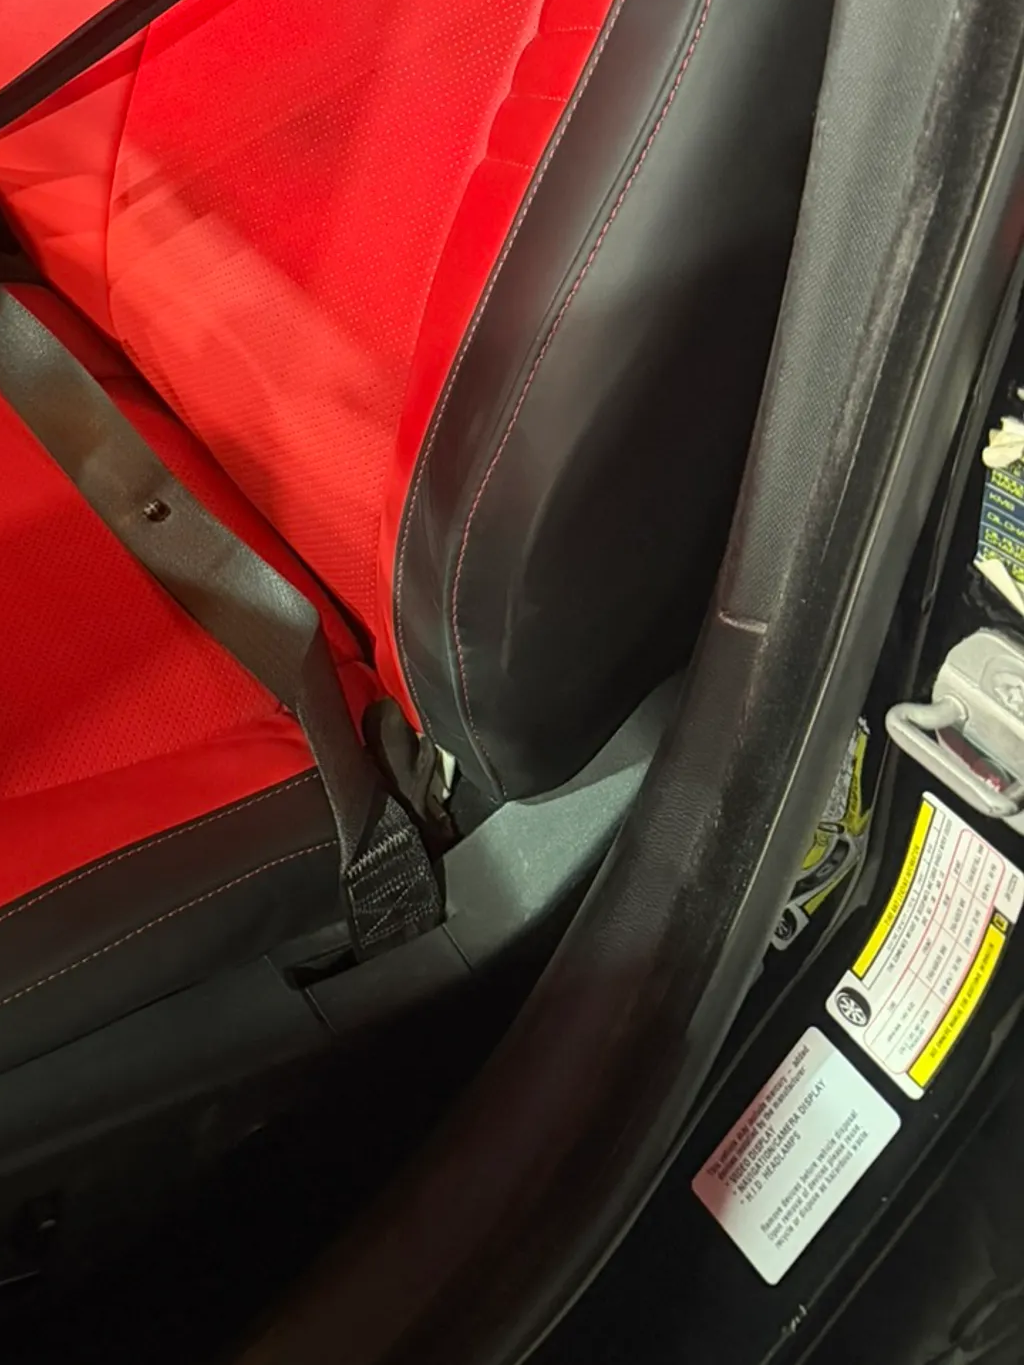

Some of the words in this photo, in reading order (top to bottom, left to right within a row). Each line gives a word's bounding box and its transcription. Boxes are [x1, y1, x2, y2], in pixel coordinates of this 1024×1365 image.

[728, 1156, 751, 1185] VIDEO
[747, 1123, 777, 1161] DISPLAY
[736, 1110, 801, 1194] NAVIGATION/CAMERA
[796, 1077, 827, 1115] DISPLAY
[760, 1129, 801, 1181] HEADLAMPS
